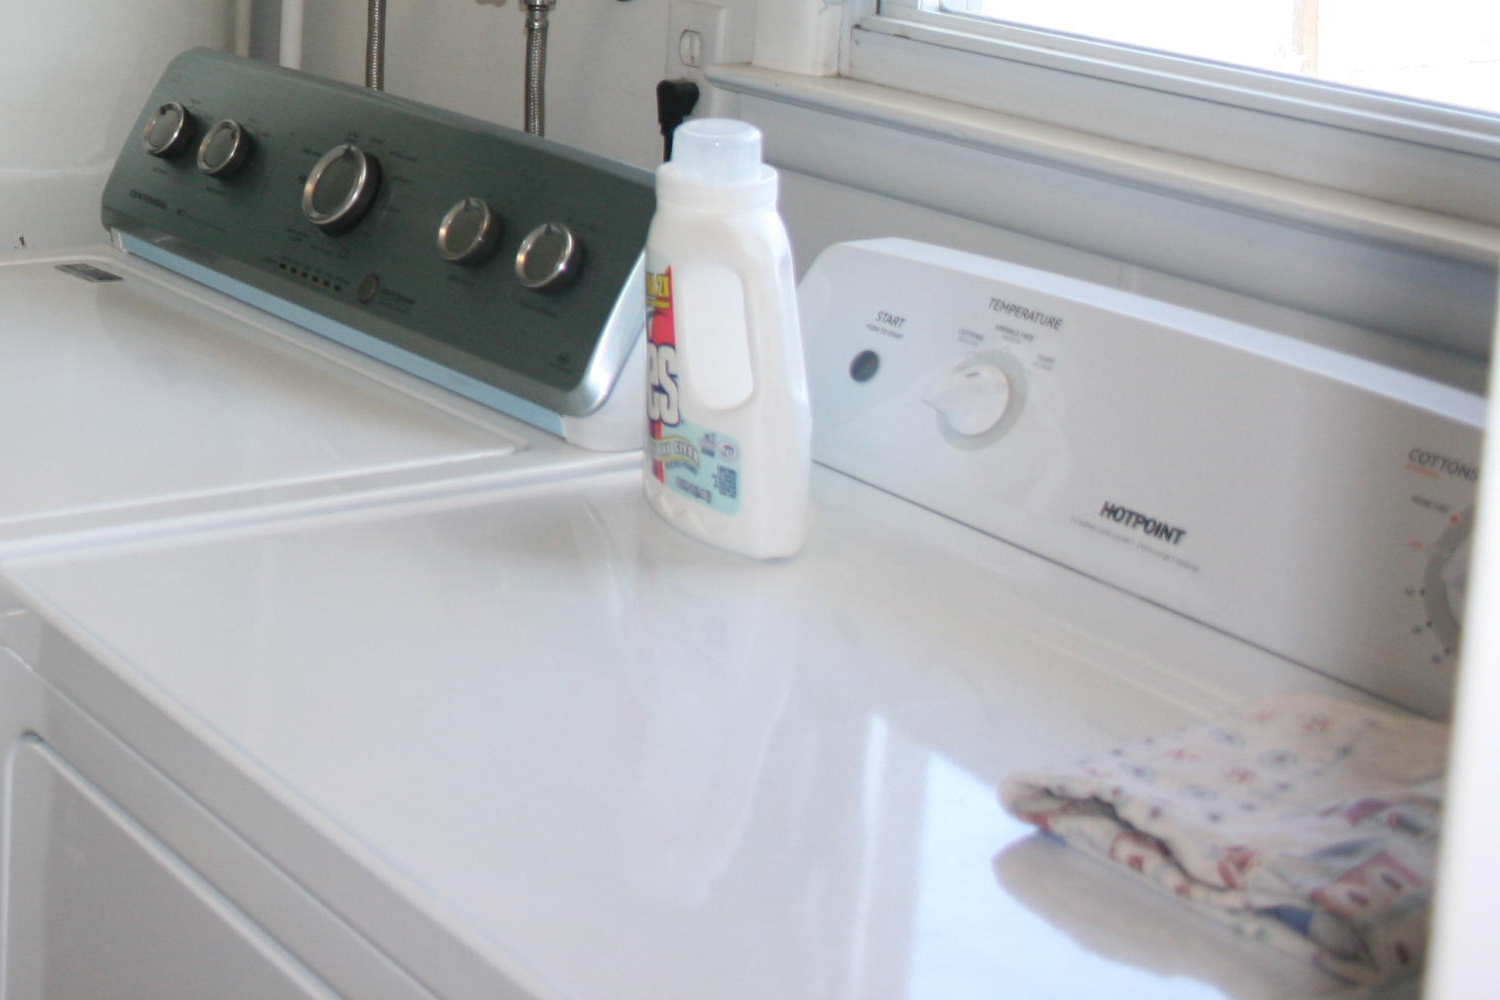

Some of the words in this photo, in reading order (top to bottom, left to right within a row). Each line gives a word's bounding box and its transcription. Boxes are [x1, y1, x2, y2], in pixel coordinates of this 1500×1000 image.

[875, 310, 907, 328] START
[989, 298, 1064, 331] TEMPERATURE
[1099, 500, 1187, 546] HOTPOINT
